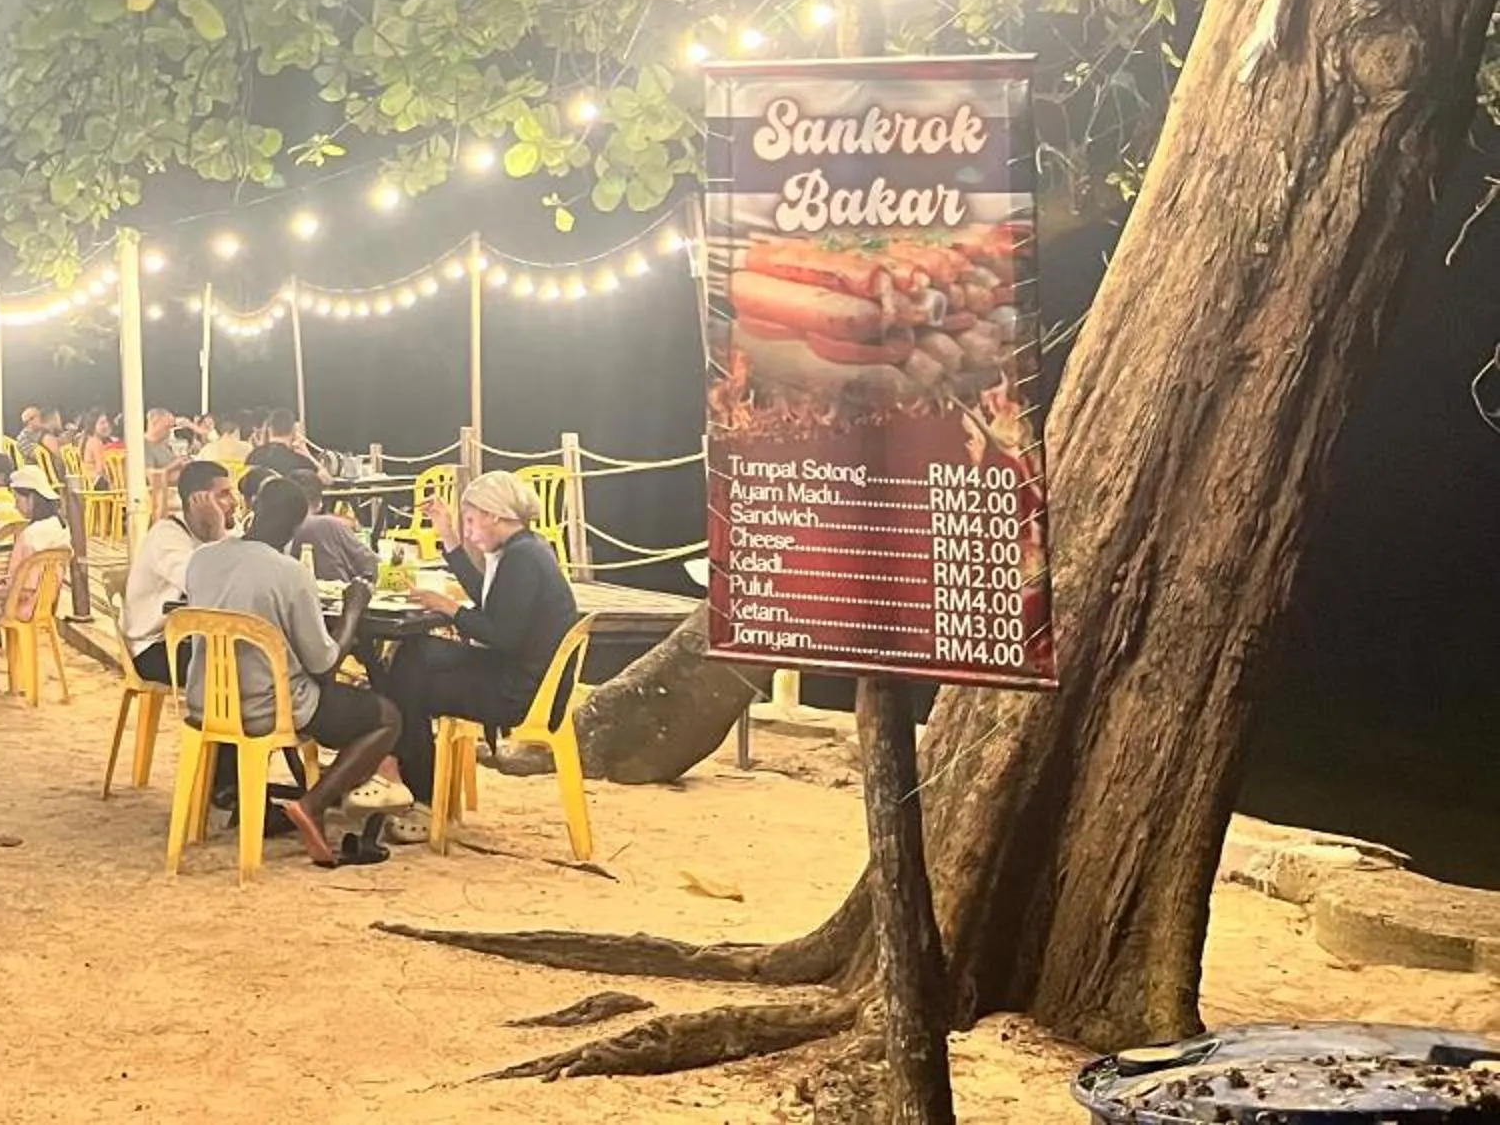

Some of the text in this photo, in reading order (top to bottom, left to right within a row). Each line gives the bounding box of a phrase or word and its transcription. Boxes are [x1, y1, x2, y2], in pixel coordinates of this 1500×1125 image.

[753, 98, 987, 161] Sankrok
[775, 168, 966, 232] Bakar
[928, 463, 1016, 490] RM4.00
[729, 479, 1017, 515] Ayam Madu RM2.00
[729, 503, 1019, 540] Sandwich RM4.00
[933, 537, 1021, 565] RM3.00
[933, 562, 1022, 590] RM2.00
[933, 587, 1023, 615] RM4.00
[934, 612, 1024, 640] RM3.00
[729, 622, 1025, 666] Tomyam RM4.00
